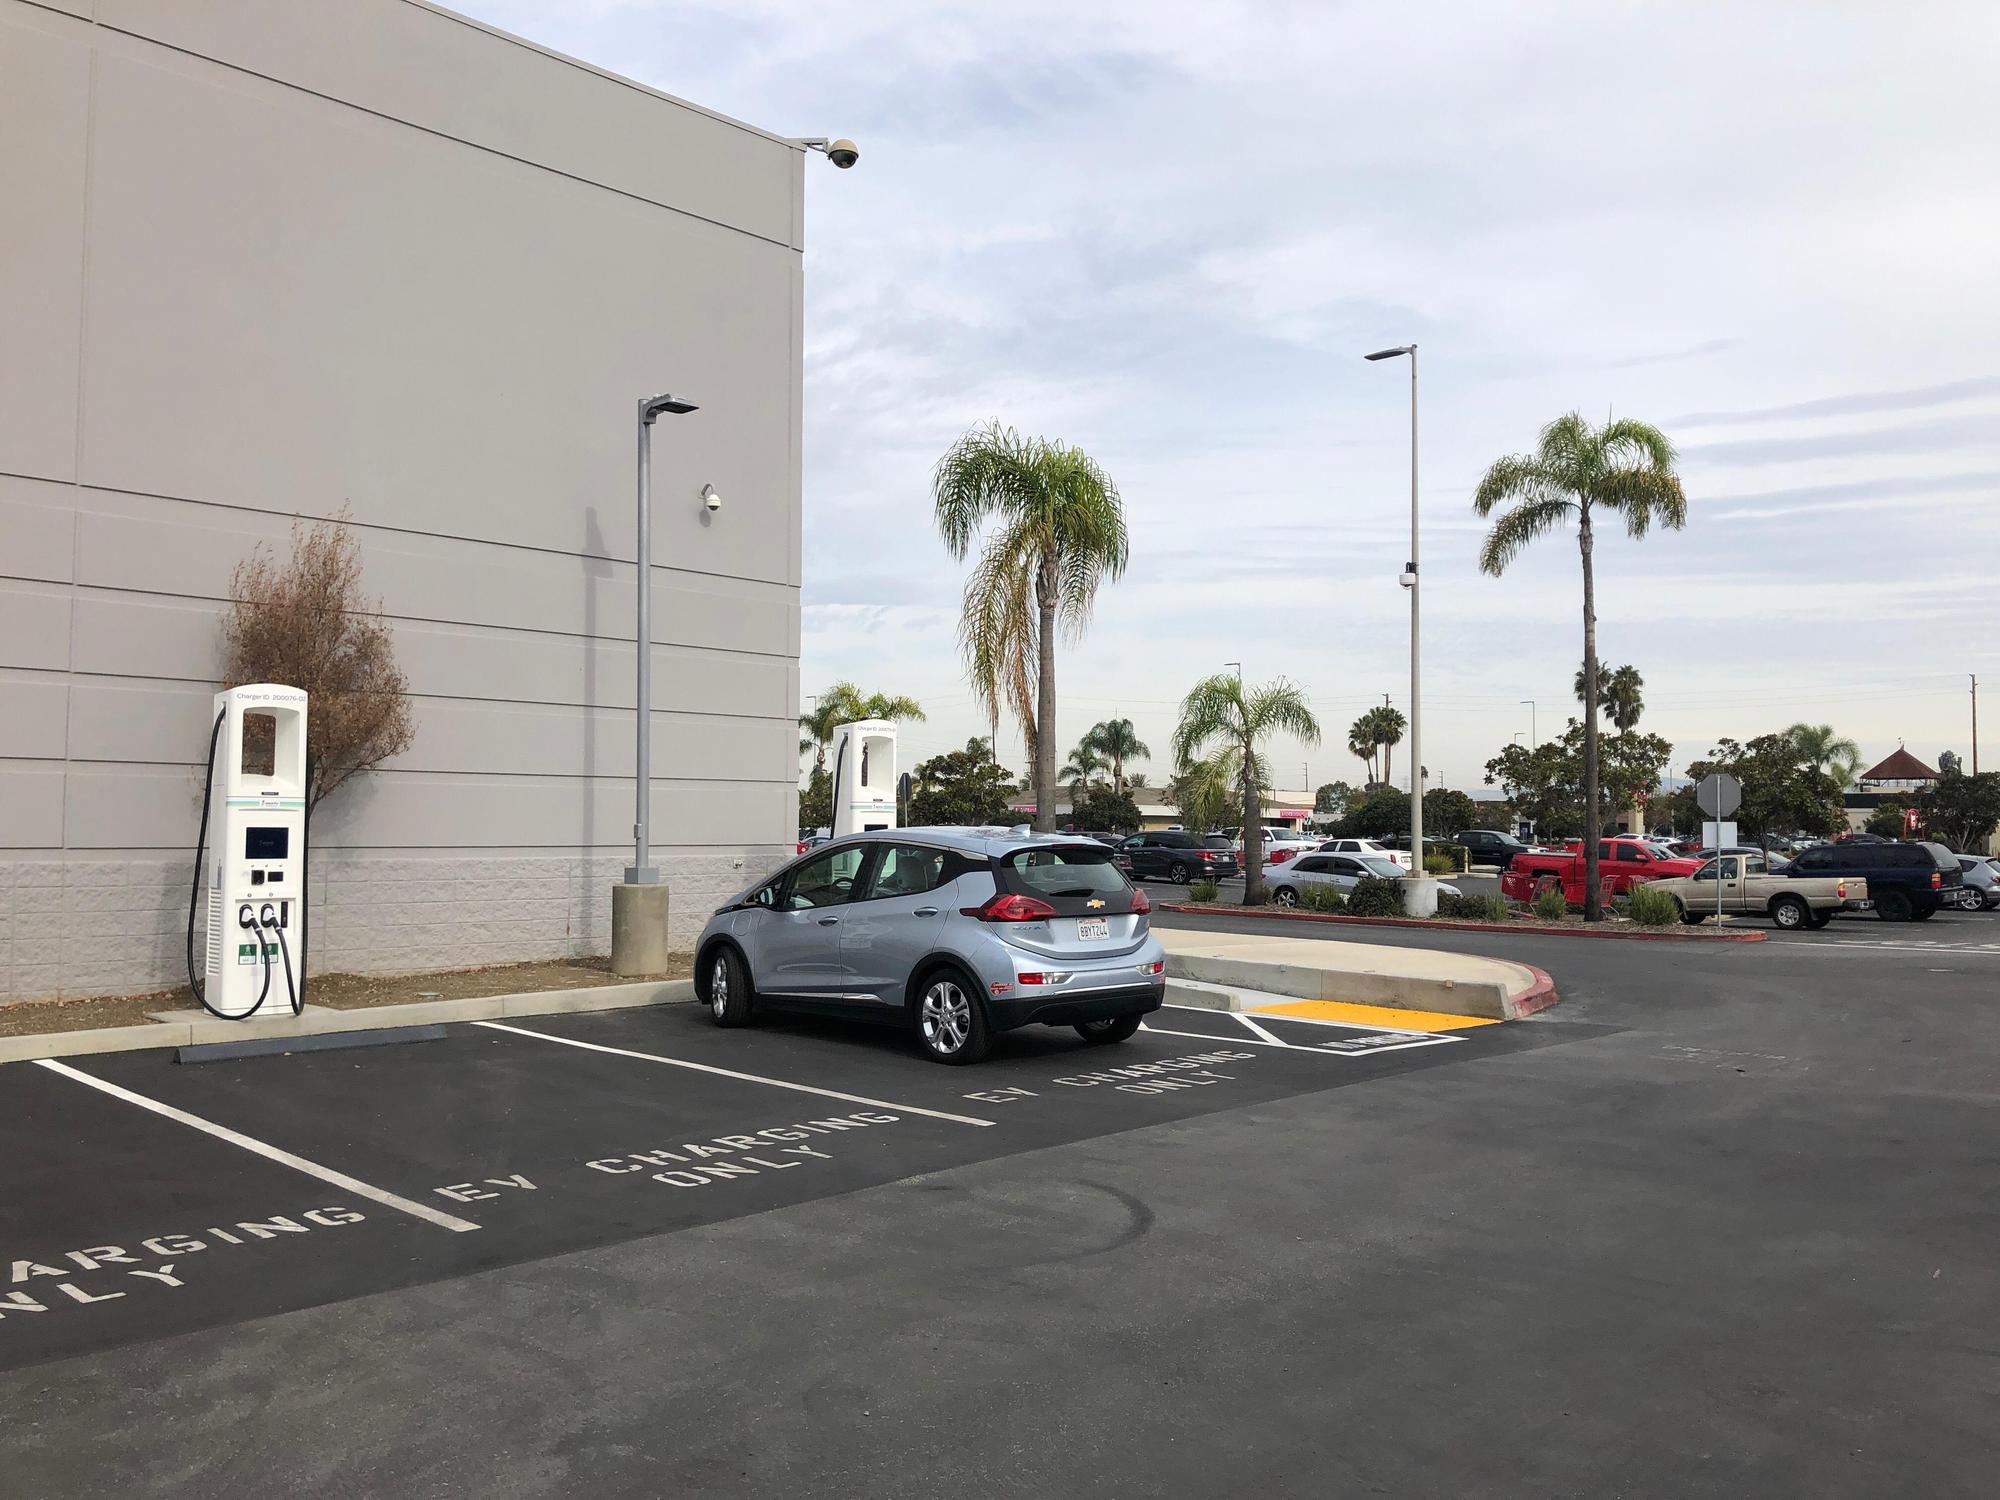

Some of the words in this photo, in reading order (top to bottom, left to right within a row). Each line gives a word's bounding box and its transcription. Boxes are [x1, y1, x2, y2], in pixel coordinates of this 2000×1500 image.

[236, 693, 261, 701] Charger
[961, 1086, 1040, 1103] EV
[1052, 1050, 1257, 1087] CHARGING
[1113, 1070, 1237, 1095] ONLY
[432, 1174, 538, 1203] EV
[585, 1112, 901, 1174] CHARGING
[651, 1144, 833, 1188] ONLY
